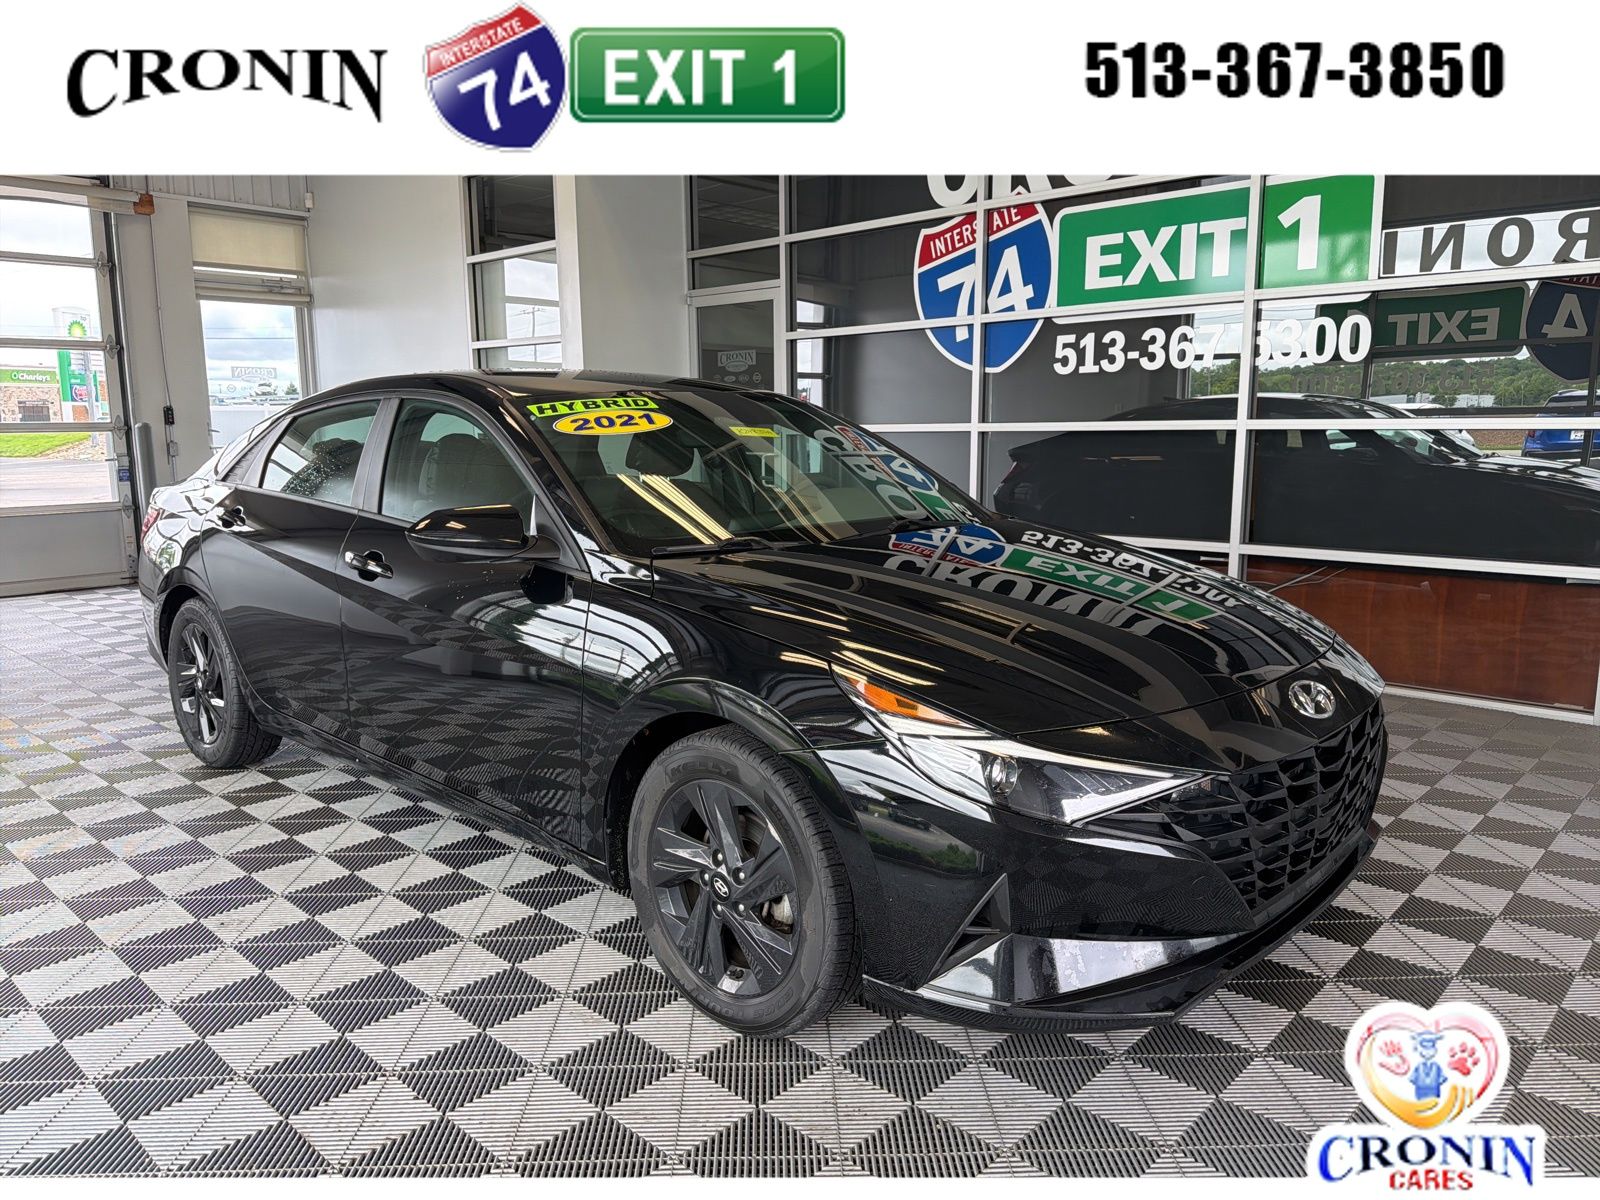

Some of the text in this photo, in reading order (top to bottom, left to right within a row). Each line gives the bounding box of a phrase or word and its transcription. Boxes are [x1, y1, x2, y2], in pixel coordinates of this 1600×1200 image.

[929, 206, 1022, 259] INTERSATE
[1085, 195, 1321, 290] EXIT 1
[720, 351, 754, 365] CRONIN
[1053, 313, 1372, 375] 513-3675300
[536, 398, 650, 415] HYBRID
[570, 413, 656, 432] 2021
